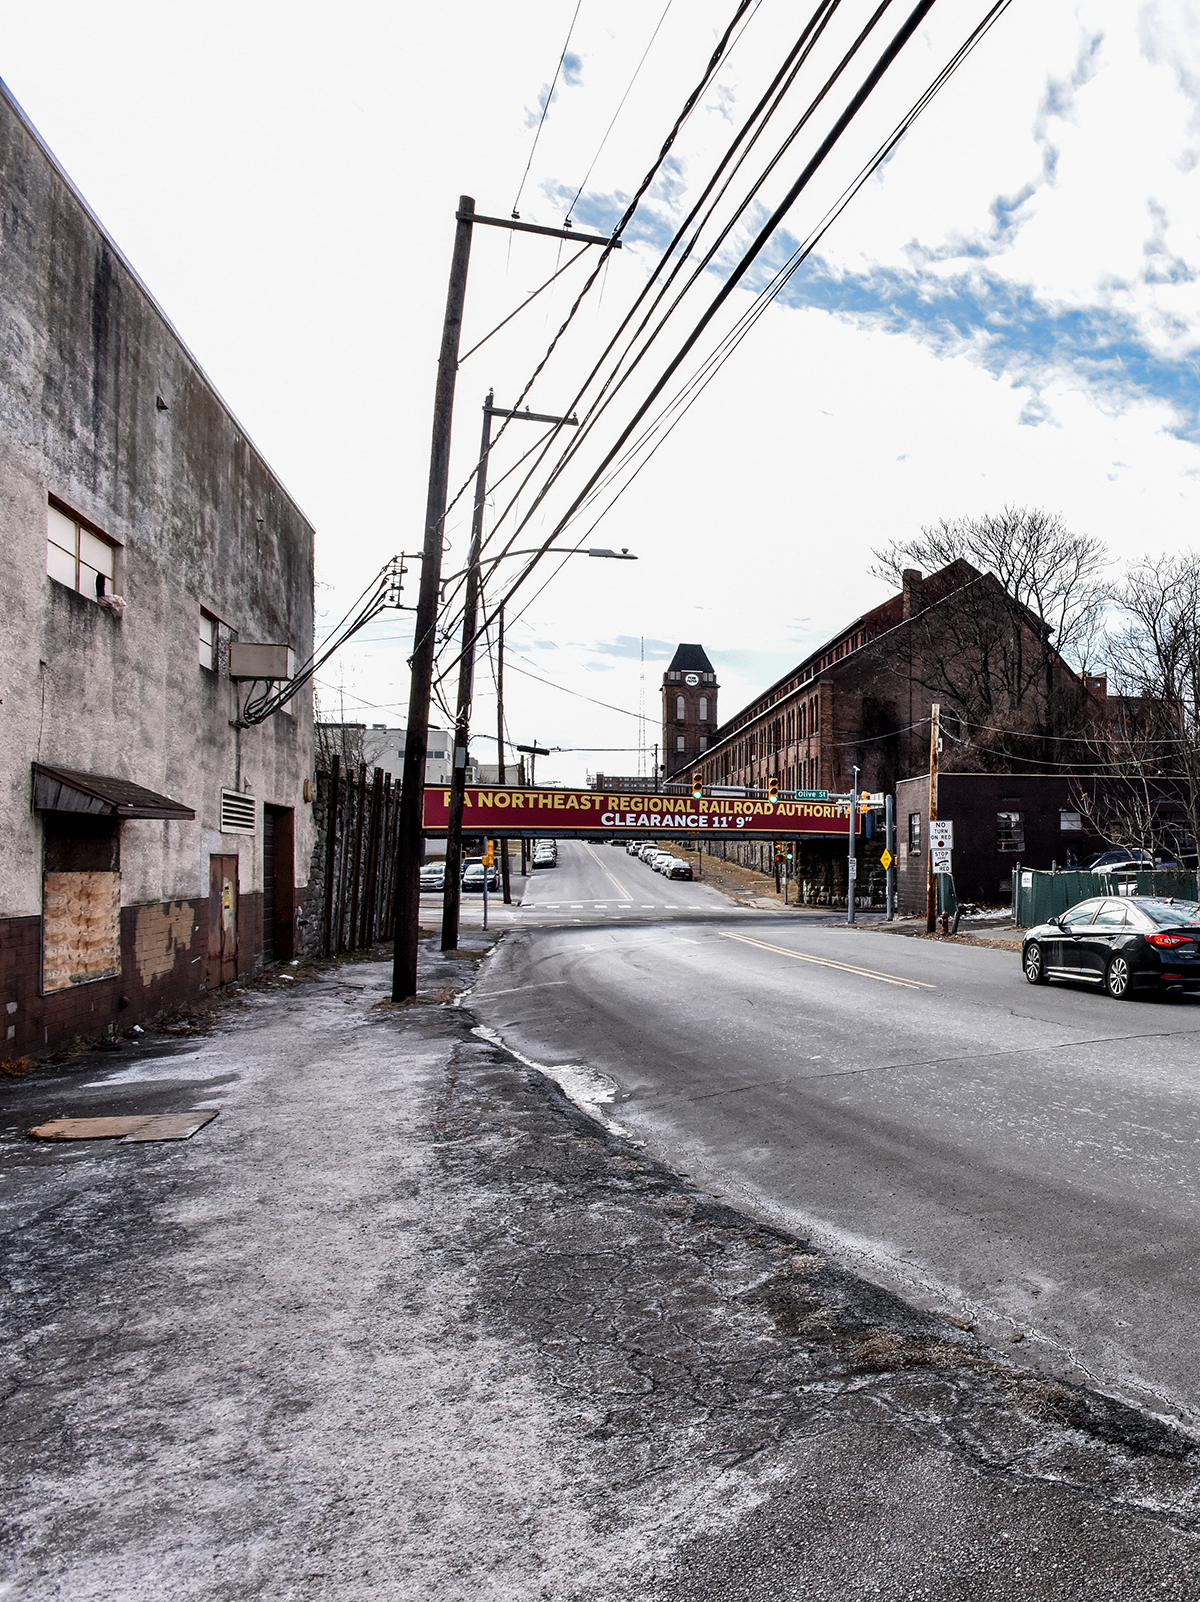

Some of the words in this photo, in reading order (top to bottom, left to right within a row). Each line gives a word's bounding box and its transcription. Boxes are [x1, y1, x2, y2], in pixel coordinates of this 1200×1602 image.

[477, 792, 604, 811] NORTHEAST
[608, 797, 696, 813] REGIONAL
[699, 801, 774, 815] RAILROAD
[601, 813, 709, 828] CLEARANCE
[712, 816, 732, 828] 11'
[736, 816, 753, 828] 9"
